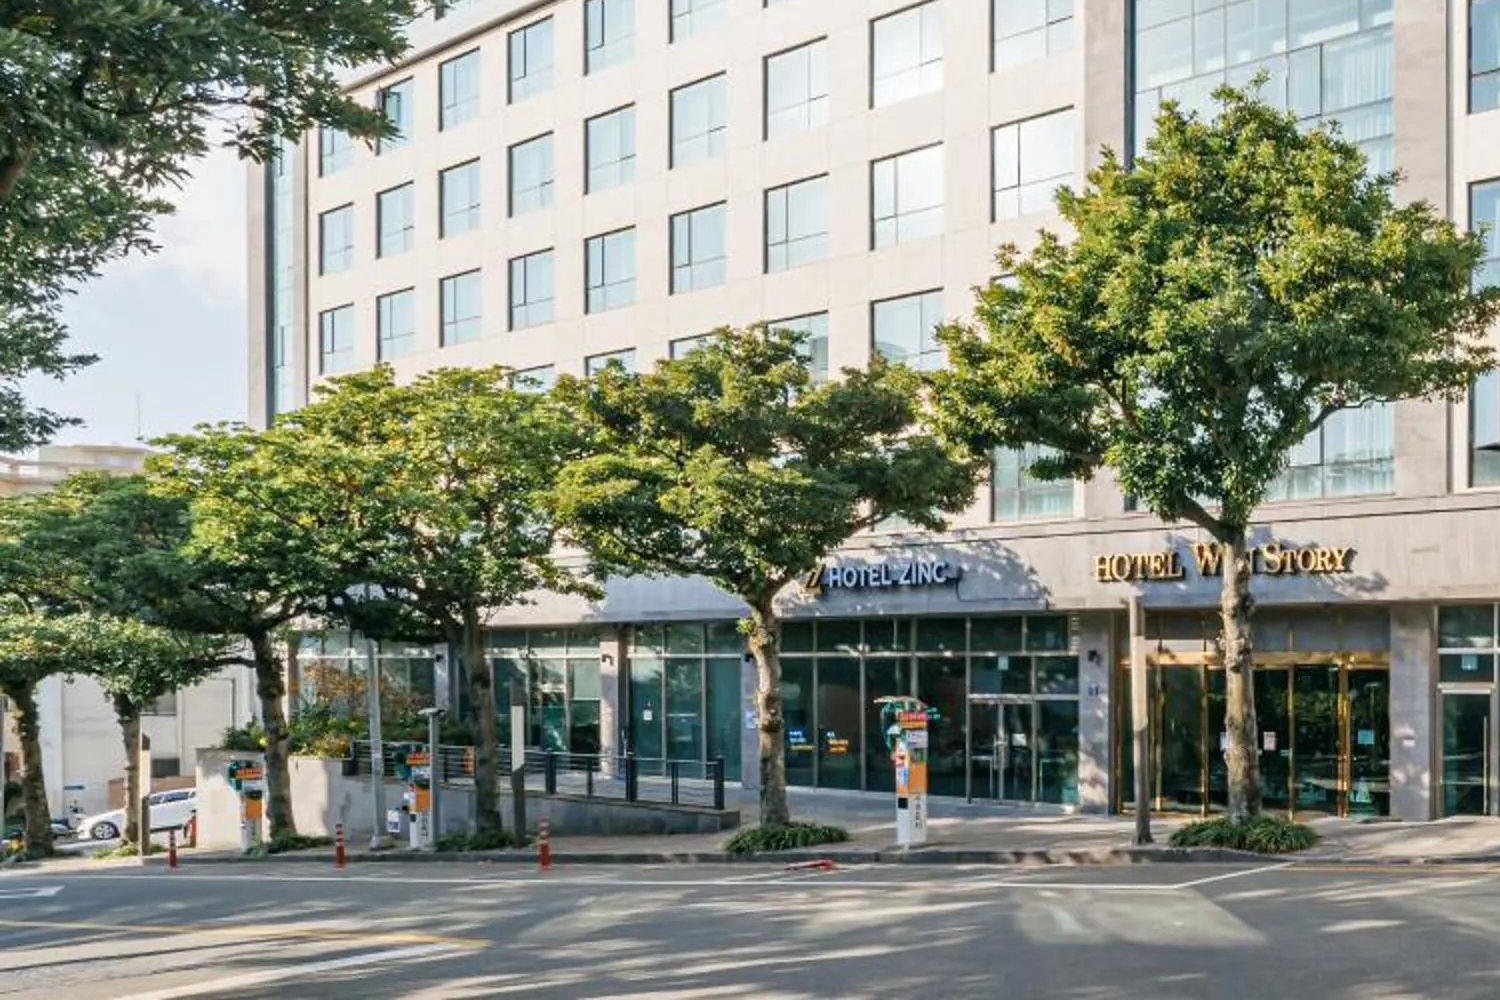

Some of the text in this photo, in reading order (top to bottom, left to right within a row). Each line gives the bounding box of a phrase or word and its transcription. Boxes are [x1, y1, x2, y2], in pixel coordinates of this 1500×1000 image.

[828, 561, 948, 589] HOTEL ZINC
[1094, 553, 1184, 580] HOTEL
[1262, 542, 1348, 573] STORY
